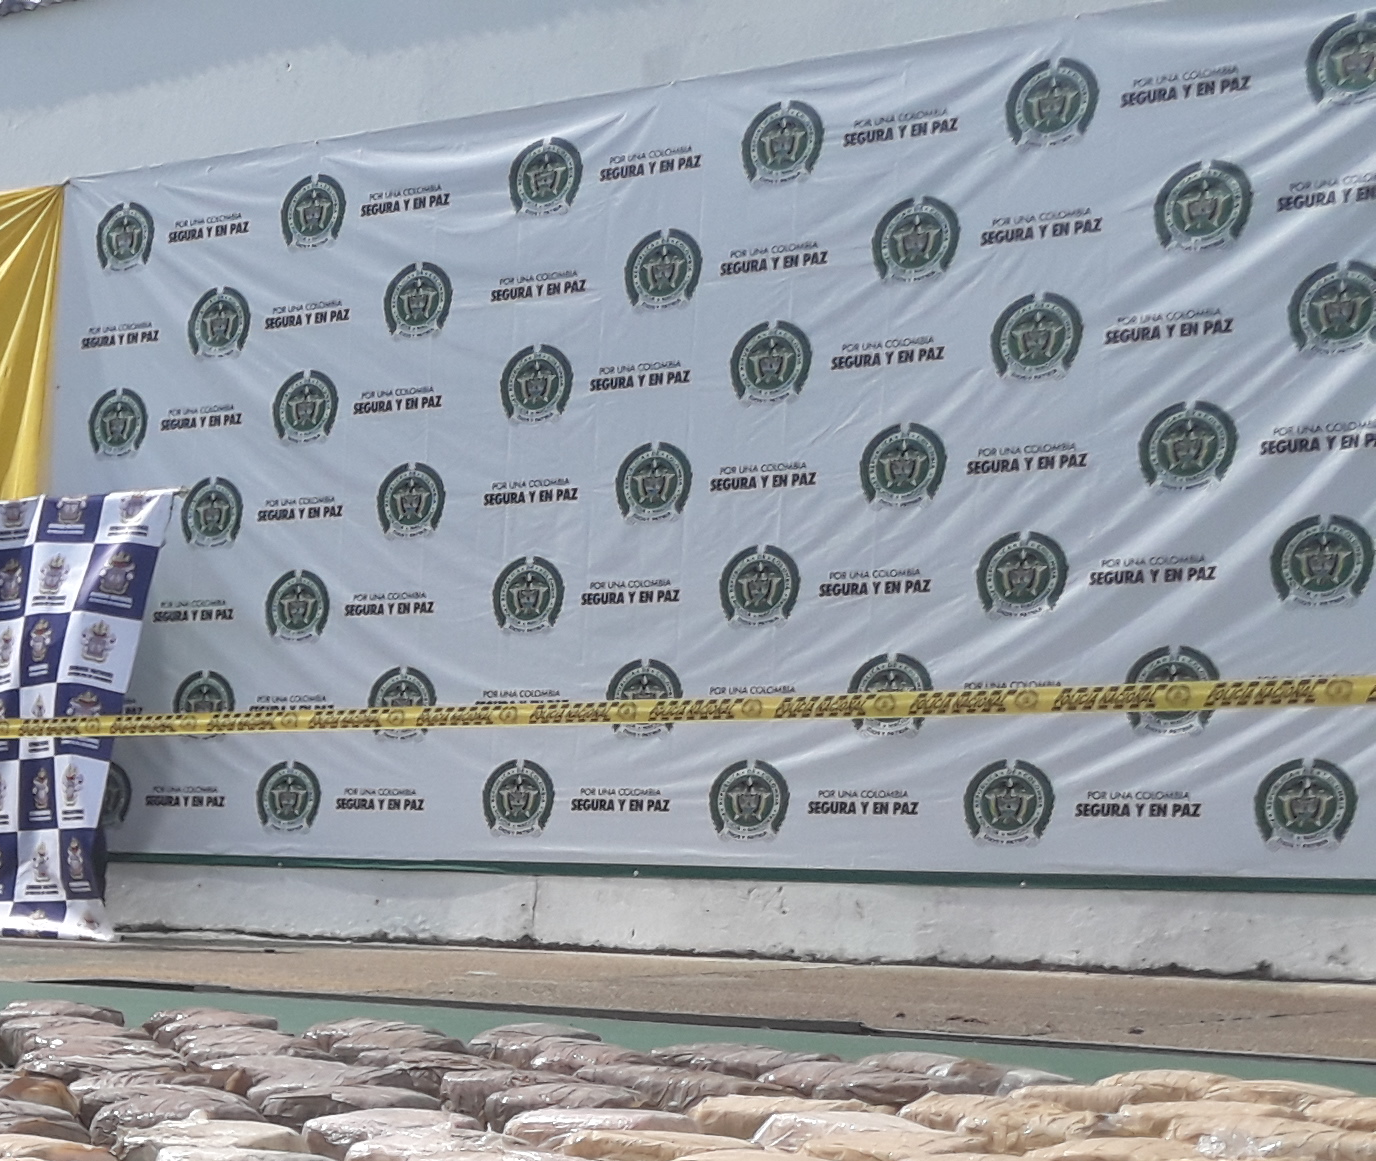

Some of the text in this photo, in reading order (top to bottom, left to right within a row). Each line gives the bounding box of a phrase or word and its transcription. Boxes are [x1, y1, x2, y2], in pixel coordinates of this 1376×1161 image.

[842, 127, 894, 147] SEGURA
[910, 122, 928, 137] EN
[930, 117, 959, 134] PAZ
[599, 163, 645, 181] SEGURA
[659, 158, 675, 173] EN
[677, 155, 702, 170] PAZ
[360, 200, 401, 217] SEGURA
[412, 196, 427, 210] EN
[428, 193, 450, 207] PAZ
[214, 224, 228, 237] EN
[229, 221, 249, 235] PAZ
[980, 227, 1034, 246] SEGURA
[1051, 222, 1071, 237] EN
[1073, 217, 1103, 234] PAZ
[720, 258, 768, 276] SEGURA
[782, 254, 799, 269] EN
[802, 251, 828, 266] PAZ
[490, 286, 533, 302] SEGURA
[546, 282, 561, 296] EN
[563, 279, 586, 294] PAZ
[264, 314, 303, 329] SEGURA
[314, 311, 328, 324] EN
[329, 308, 350, 322] PAZ
[1104, 326, 1161, 345] SEGURA
[1179, 322, 1199, 337] EN
[1202, 318, 1234, 335] PAZ
[830, 353, 881, 370] SEGURA
[897, 349, 915, 364] EN
[917, 346, 945, 362] PAZ
[589, 375, 634, 391] SEGURA
[648, 372, 664, 386] EN
[666, 370, 691, 384] PAZ
[353, 400, 393, 415] SEGURA
[405, 397, 419, 410] EN
[421, 395, 442, 409] PAZ
[966, 458, 1020, 475] SEGURA
[1036, 455, 1056, 470] EN
[1058, 453, 1088, 469] PAZ
[709, 476, 757, 492] SEGURA
[771, 474, 788, 488] EN
[791, 472, 817, 486] PAZ
[483, 491, 526, 506] SEGURA
[538, 489, 553, 503] EN
[556, 487, 578, 501] PAZ
[1089, 570, 1145, 585] SEGURA
[1163, 568, 1183, 583] EN
[1186, 566, 1217, 581] PAZ
[580, 592, 625, 606] SEGURA
[638, 590, 654, 604] EN
[656, 589, 680, 603] PAZ
[818, 582, 868, 597] SEGURA
[884, 580, 902, 595] EN
[904, 579, 931, 593] PAZ
[344, 603, 385, 616] SEGURA
[397, 602, 411, 615] EN
[413, 601, 434, 614] PAZ
[335, 798, 375, 810] SEGURA
[387, 798, 401, 811] EN
[403, 798, 424, 811] PAZ
[570, 798, 615, 811] SEGURA
[628, 799, 644, 812] EN
[646, 799, 670, 812] PAZ
[807, 801, 857, 815] SEGURA
[872, 801, 889, 815] EN
[892, 801, 919, 815] PAZ
[1074, 803, 1131, 817] SEGURA
[1148, 803, 1168, 817] EN
[1171, 803, 1202, 817] PAZ
